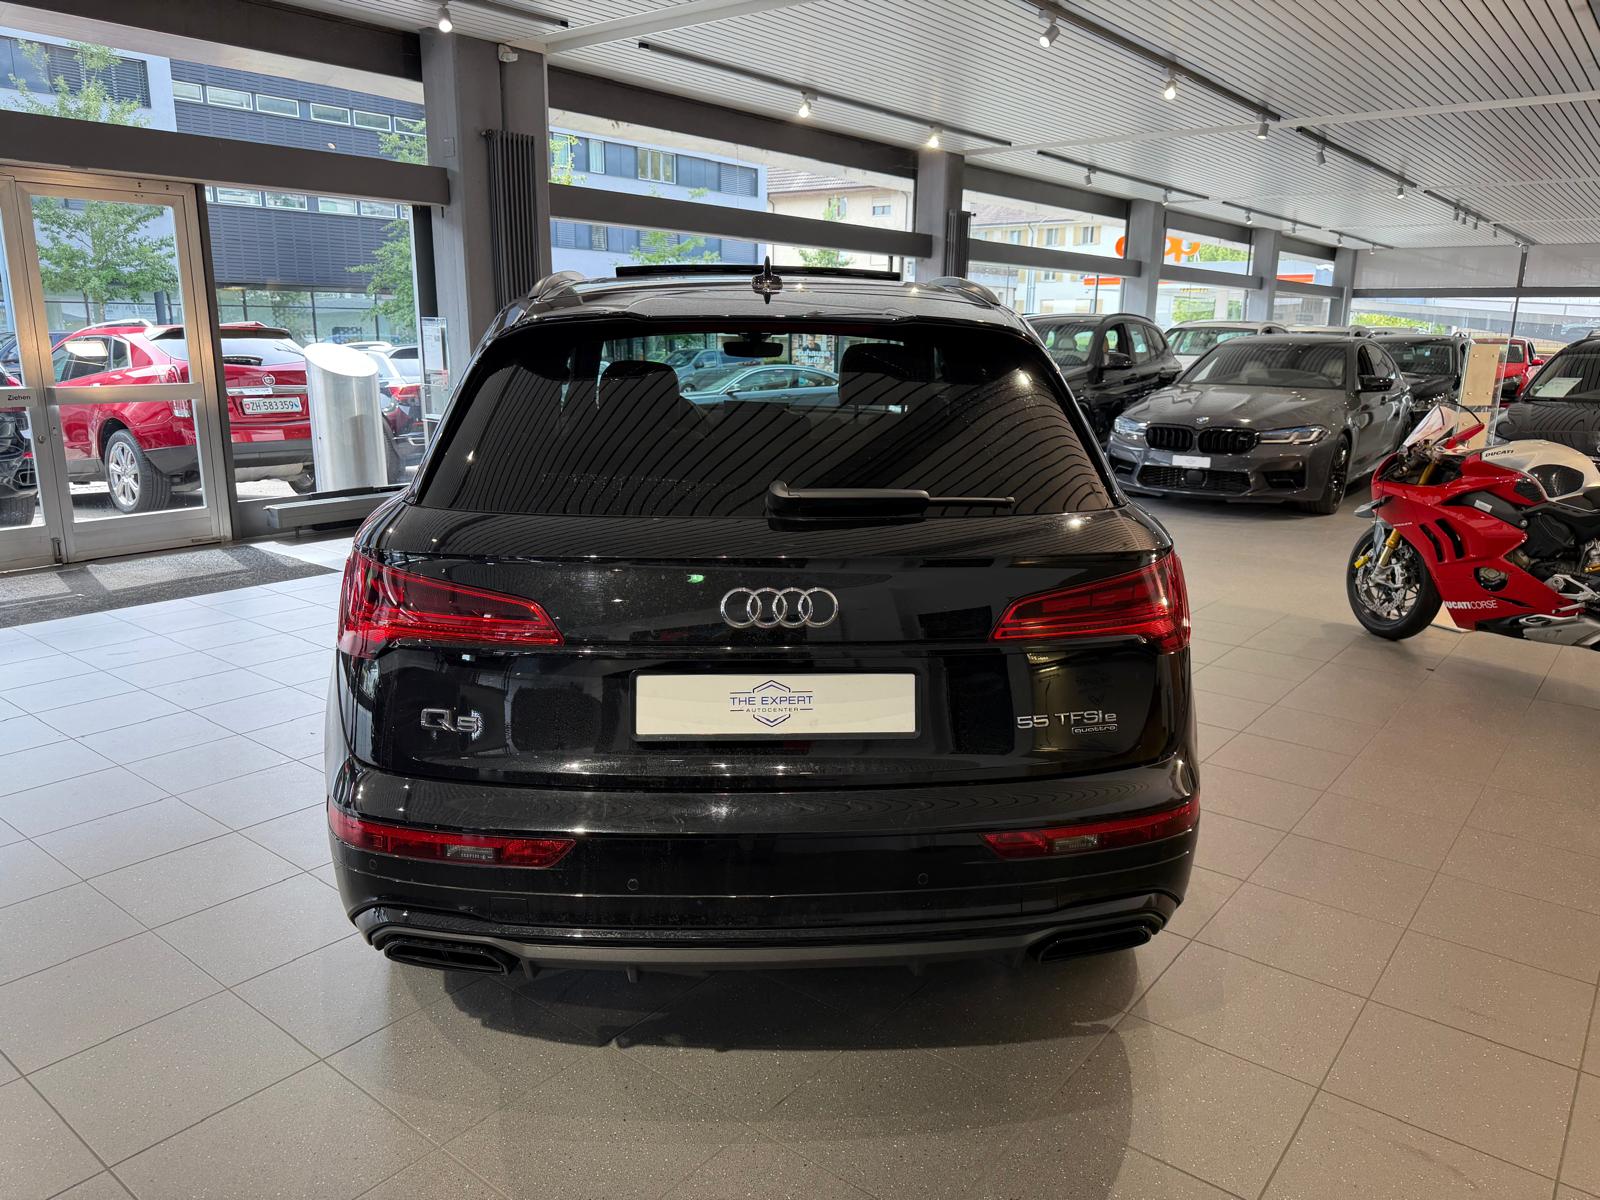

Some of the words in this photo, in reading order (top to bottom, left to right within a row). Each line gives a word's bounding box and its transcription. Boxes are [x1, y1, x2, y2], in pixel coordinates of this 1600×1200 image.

[250, 401, 262, 411] ZH
[1485, 449, 1514, 457] DUCATI
[729, 696, 756, 706] THE
[761, 695, 813, 706] EXPERT
[420, 708, 481, 733] Q5
[1016, 714, 1050, 729] 55
[1073, 724, 1117, 734] quattro
